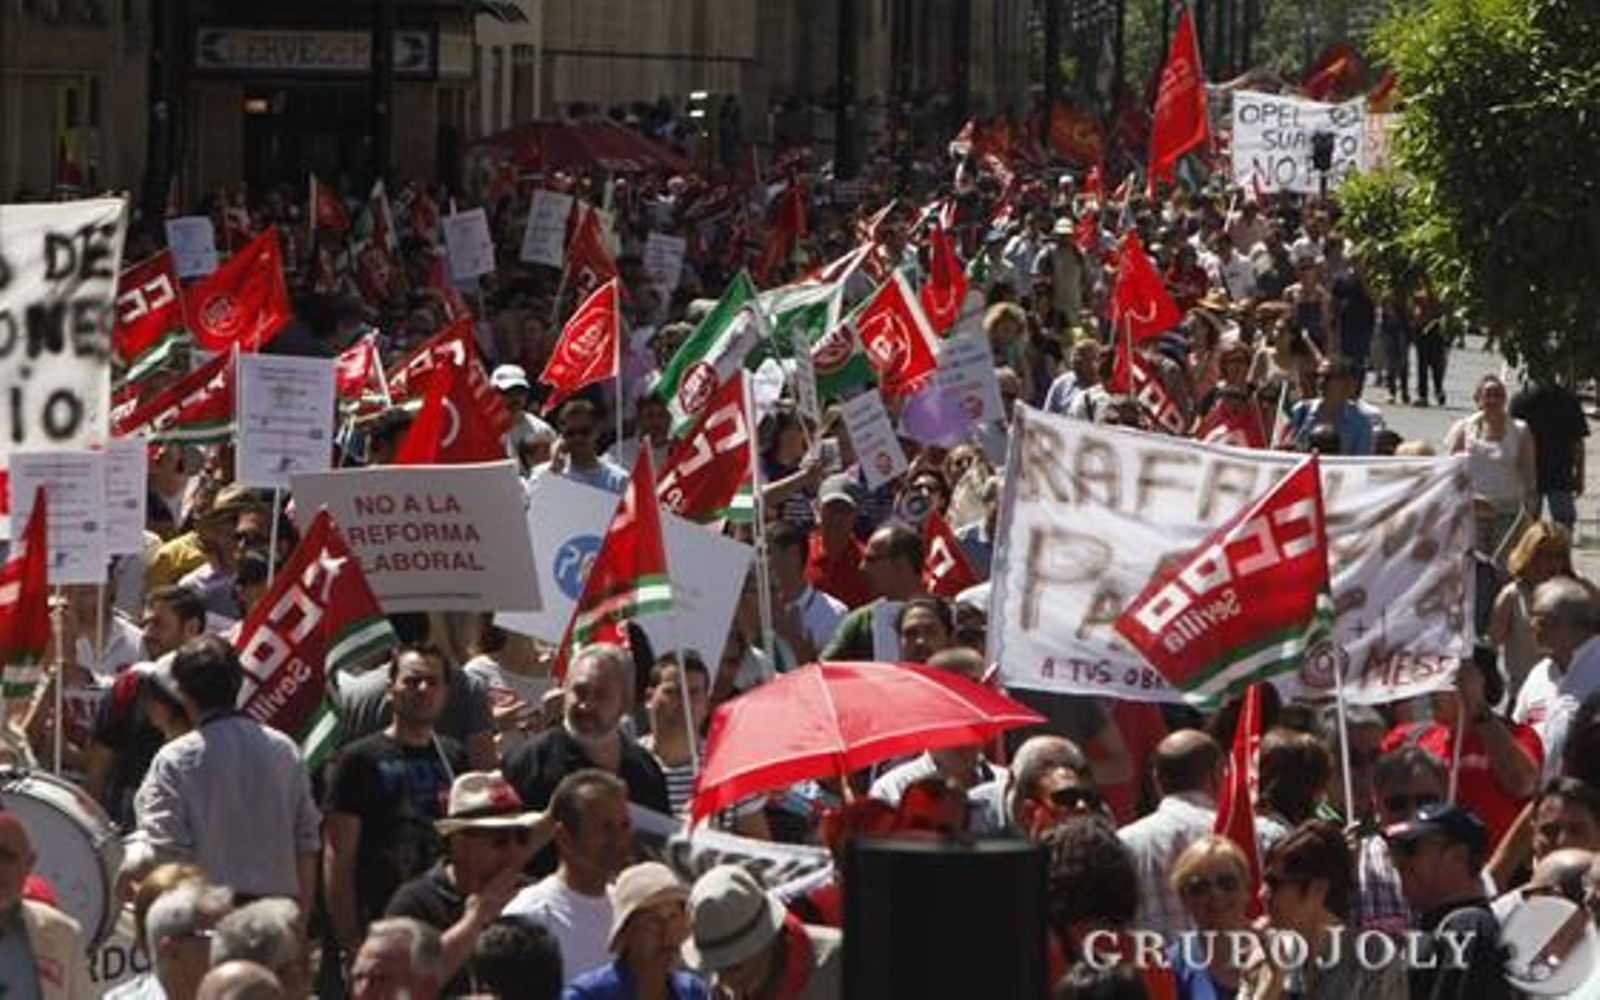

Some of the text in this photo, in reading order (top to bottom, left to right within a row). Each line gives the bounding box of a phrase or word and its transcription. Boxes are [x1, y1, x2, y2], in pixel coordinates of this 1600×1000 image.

[1238, 102, 1304, 129] OPEL
[44, 222, 116, 281] DE
[354, 493, 462, 516] NO A LA
[346, 522, 481, 546] REFORMA
